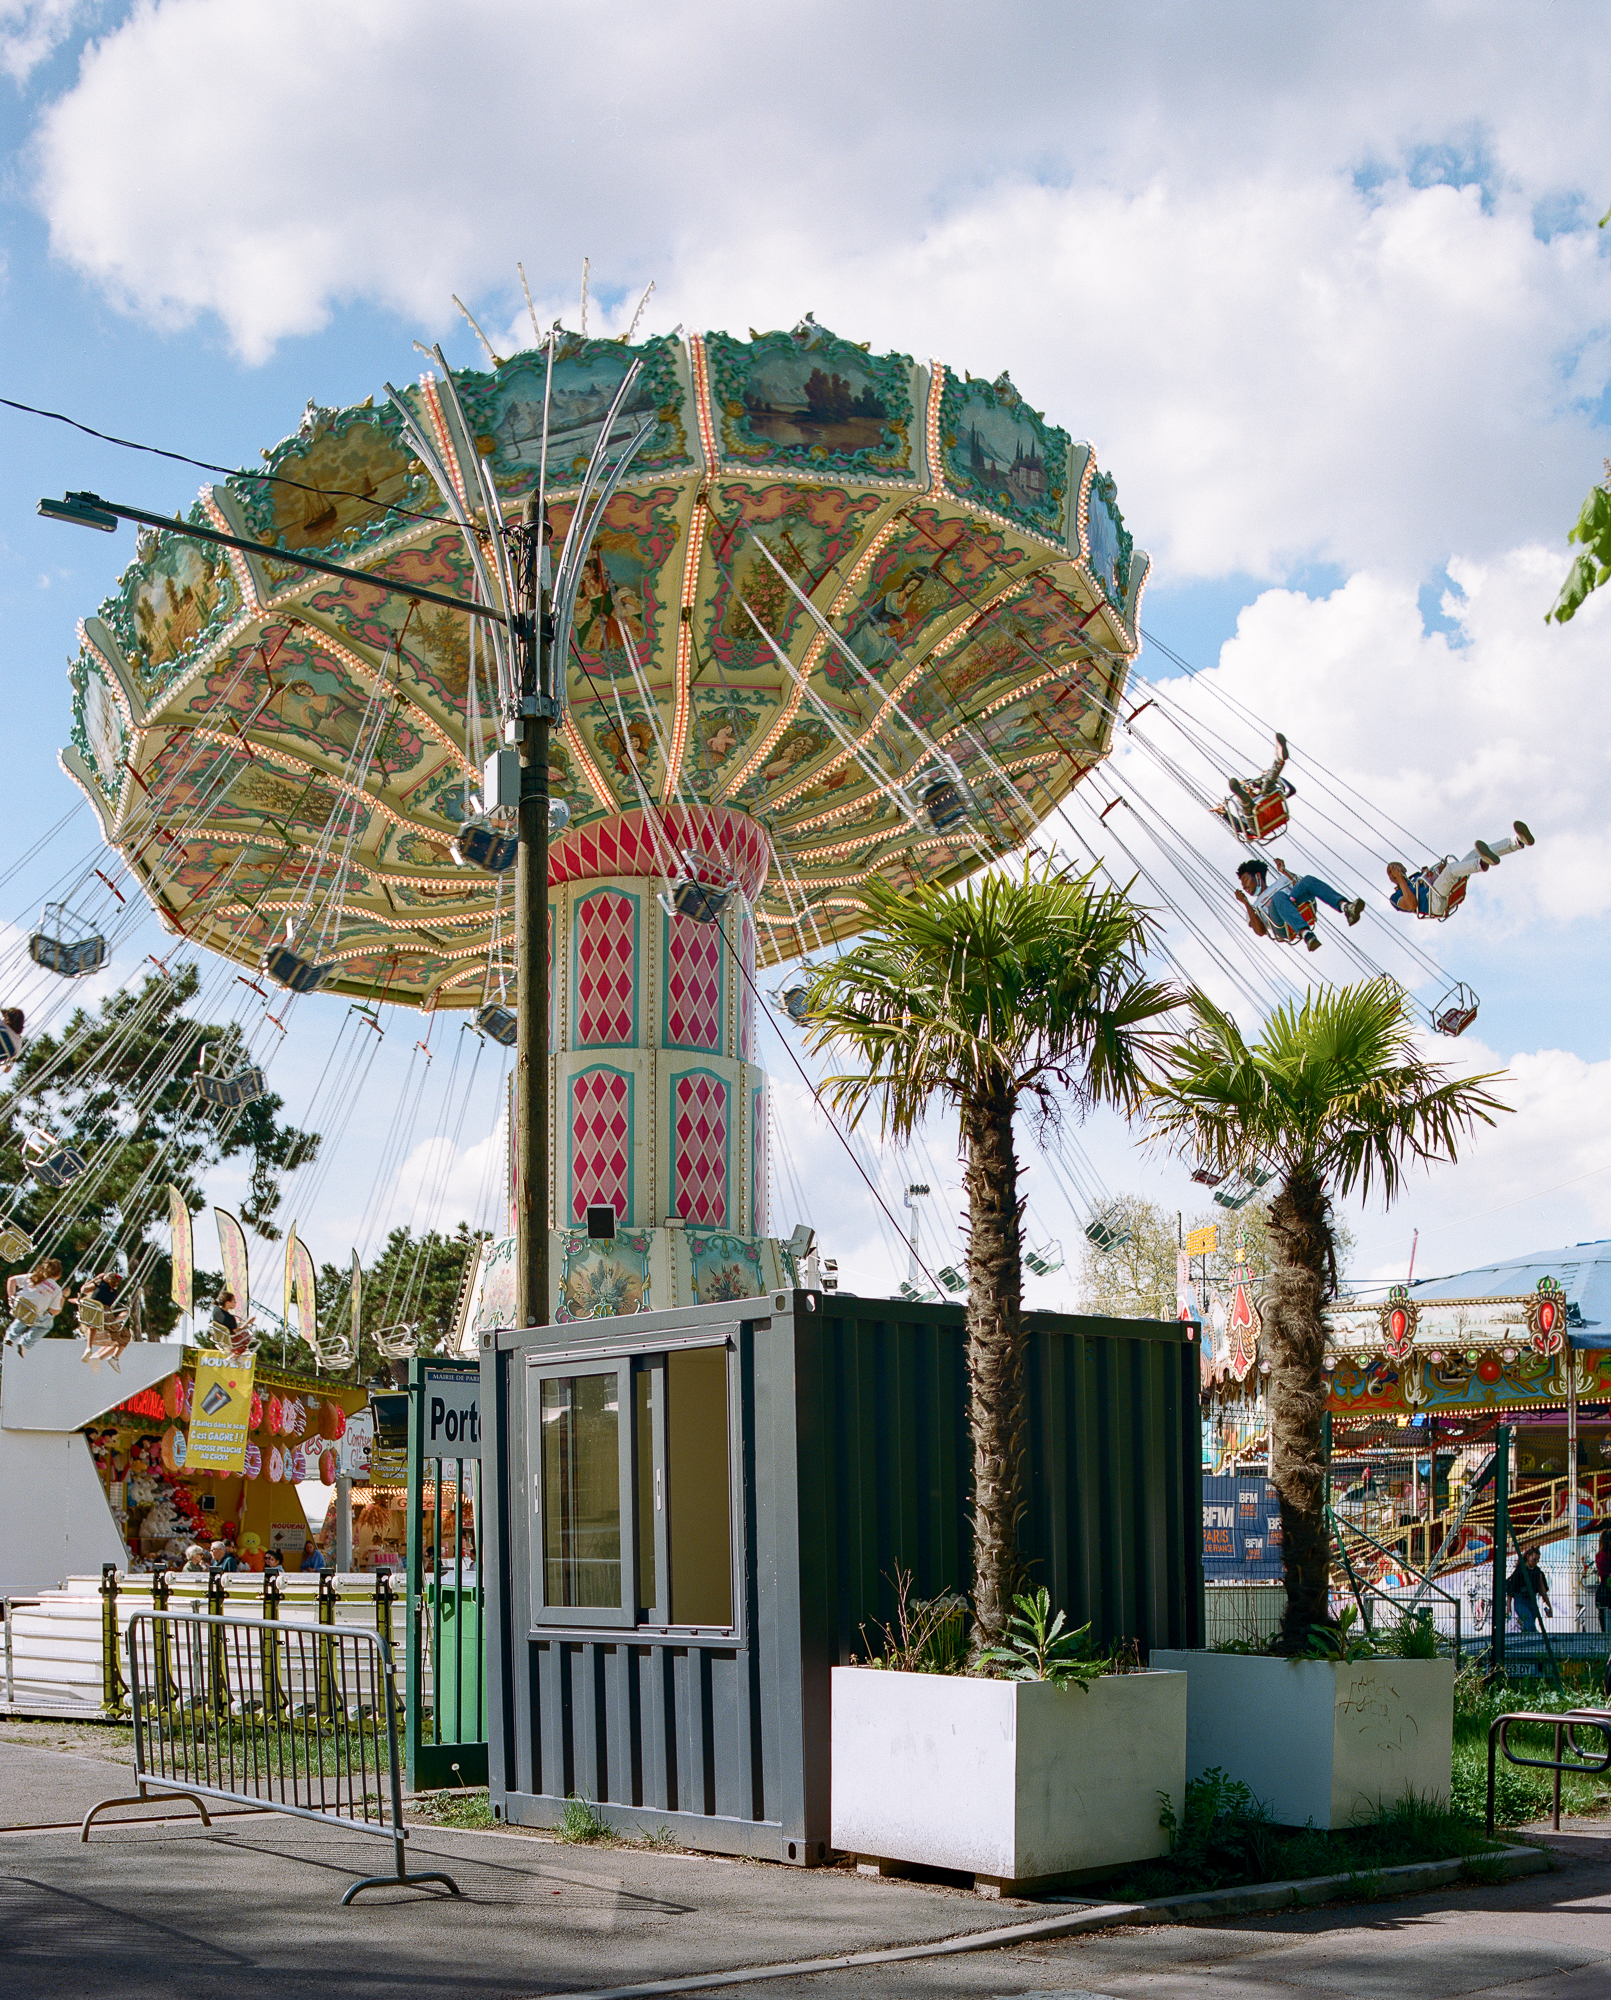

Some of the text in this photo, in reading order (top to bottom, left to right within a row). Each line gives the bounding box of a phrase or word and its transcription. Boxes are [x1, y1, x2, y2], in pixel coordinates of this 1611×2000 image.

[214, 1421, 227, 1429] dans
[431, 1397, 481, 1443] Port
[190, 1429, 208, 1440] C'est
[194, 1444, 217, 1452] GROSSE
[217, 1446, 242, 1454] PELUCHE
[210, 1453, 229, 1461] CHOIX
[1239, 1493, 1258, 1503] BFM
[1203, 1507, 1234, 1528] BFM
[1203, 1530, 1229, 1543] PARIS
[1245, 1538, 1262, 1548] BFM
